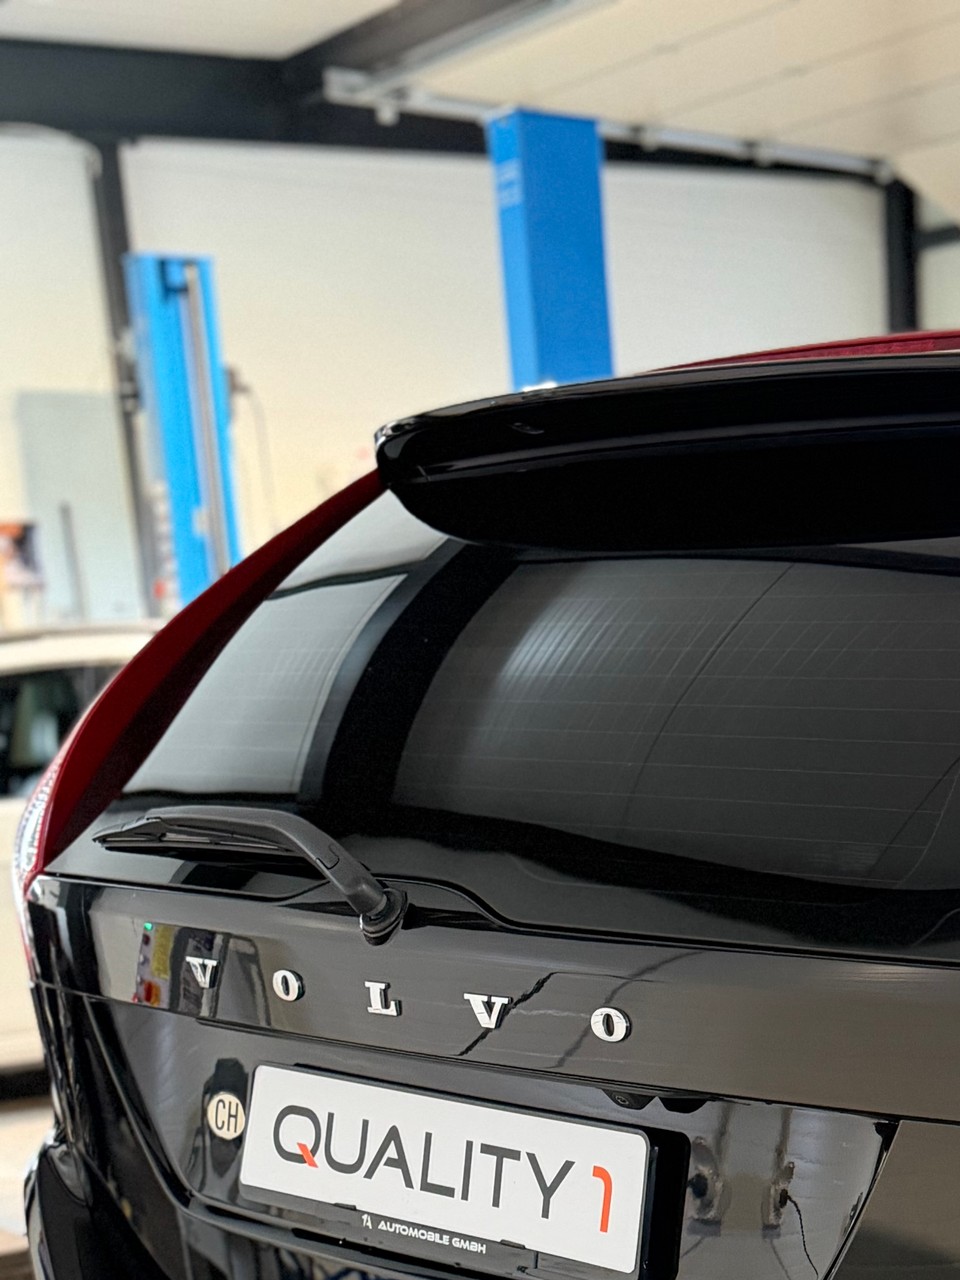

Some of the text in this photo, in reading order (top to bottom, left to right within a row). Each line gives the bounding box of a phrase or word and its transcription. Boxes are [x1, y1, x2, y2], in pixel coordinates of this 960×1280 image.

[185, 956, 630, 1043] VOLVO
[214, 1099, 240, 1134] CH
[378, 1220, 450, 1246] AUTOMOBILE
[451, 1238, 487, 1255] GMBH
